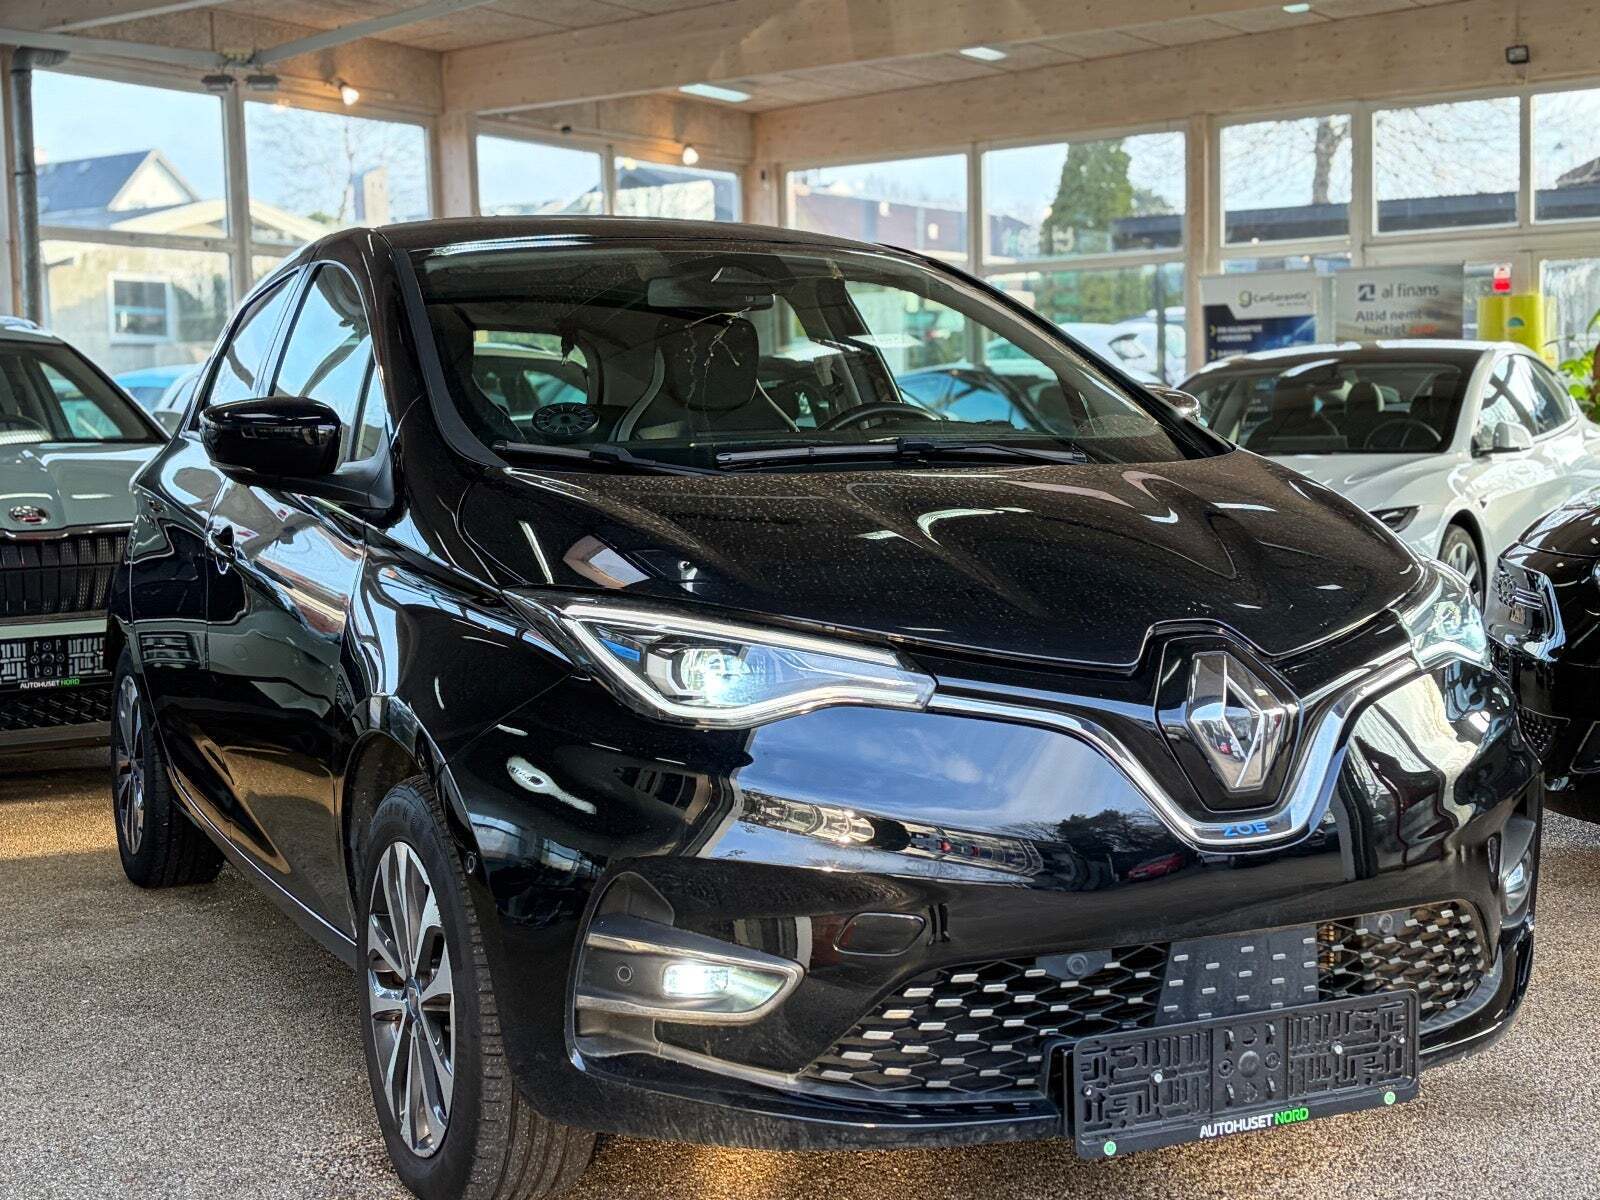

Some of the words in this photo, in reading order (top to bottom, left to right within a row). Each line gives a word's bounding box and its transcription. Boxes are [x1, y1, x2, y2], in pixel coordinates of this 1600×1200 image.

[1397, 283, 1440, 298] finans
[1355, 309, 1387, 322] Altid
[20, 679, 60, 689] AUTOHUSET
[60, 678, 80, 686] NORD
[1223, 821, 1270, 837] ZOE
[1199, 1113, 1274, 1139] AUTOHUSET
[1274, 1107, 1309, 1125] NORD
